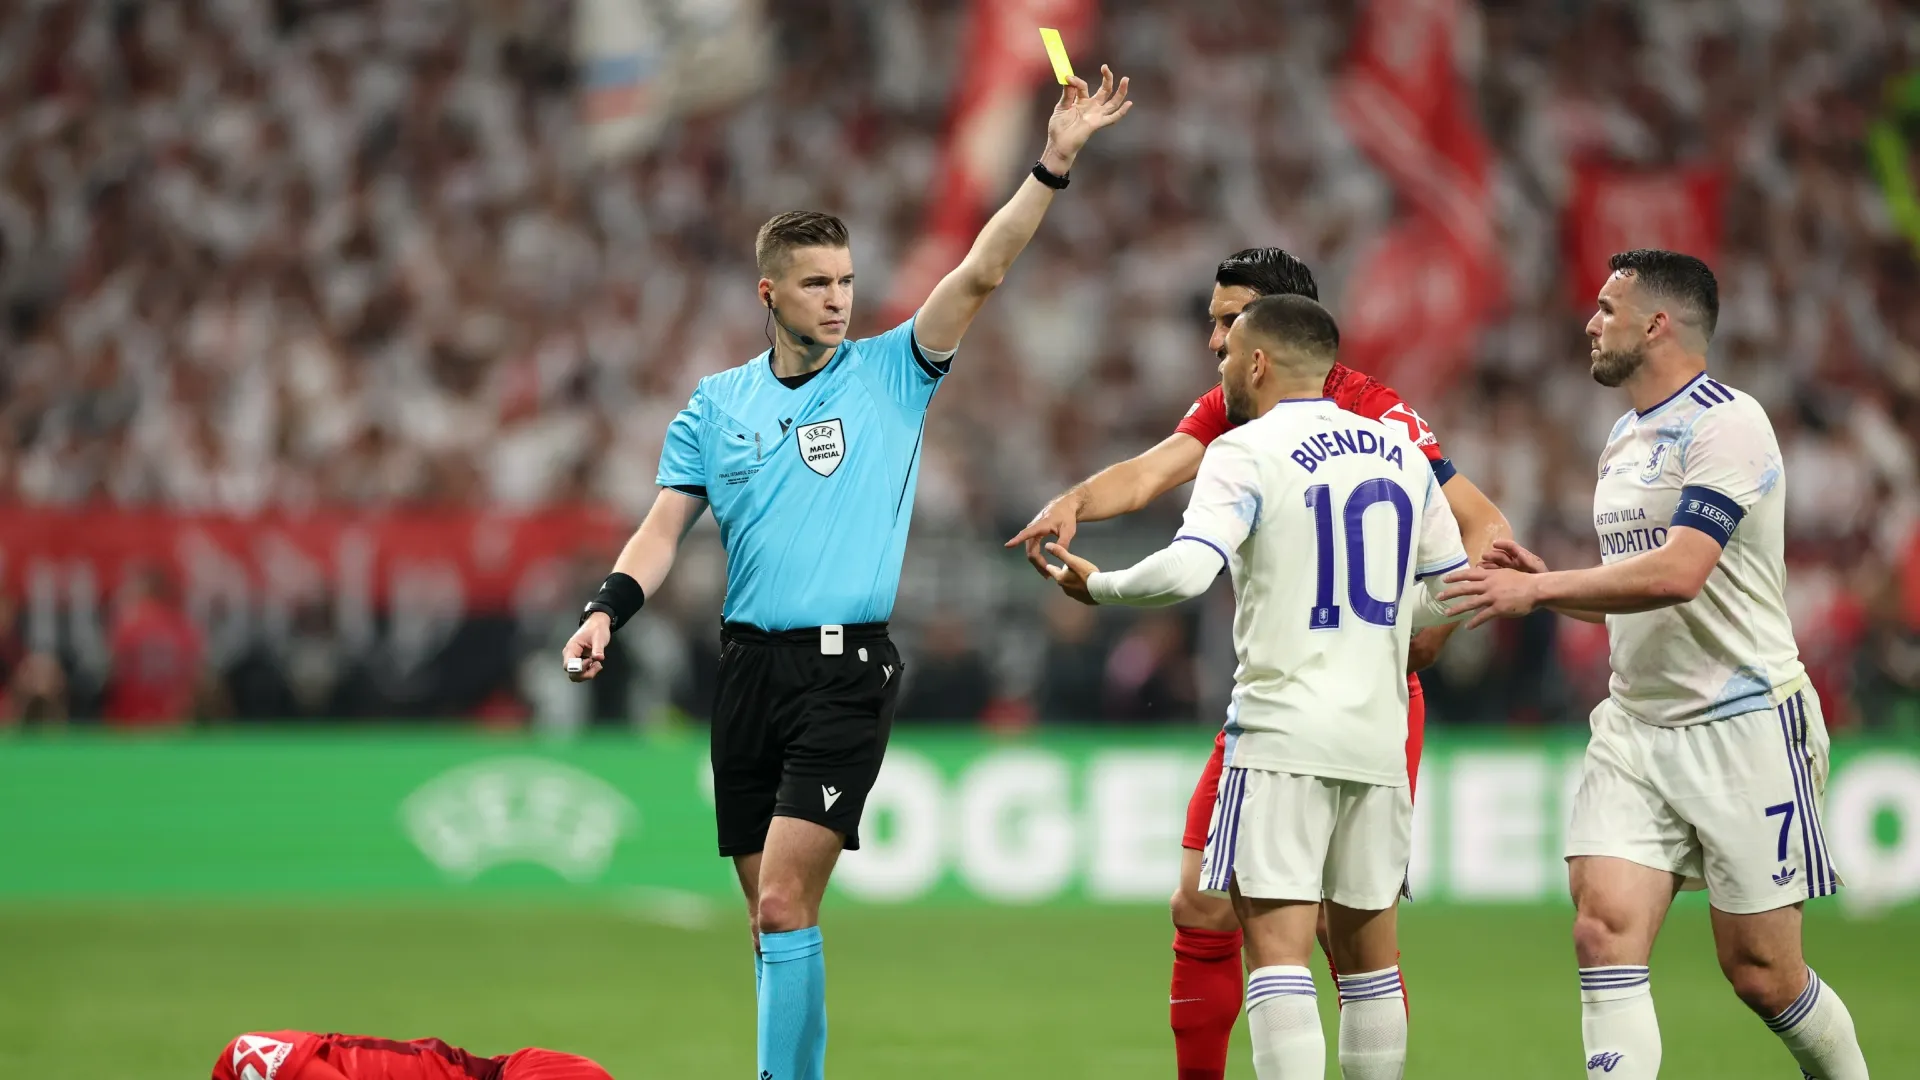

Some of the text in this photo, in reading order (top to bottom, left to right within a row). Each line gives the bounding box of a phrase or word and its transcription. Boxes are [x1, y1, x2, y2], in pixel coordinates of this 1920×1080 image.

[806, 427, 833, 440] UEFA
[808, 451, 840, 462] OFFICIAL
[809, 443, 836, 453] MATCH
[1290, 429, 1404, 474] BUENDIA
[1596, 507, 1646, 526] ASTON VILLA
[1304, 477, 1414, 630] 10
[1764, 800, 1795, 862] 7
